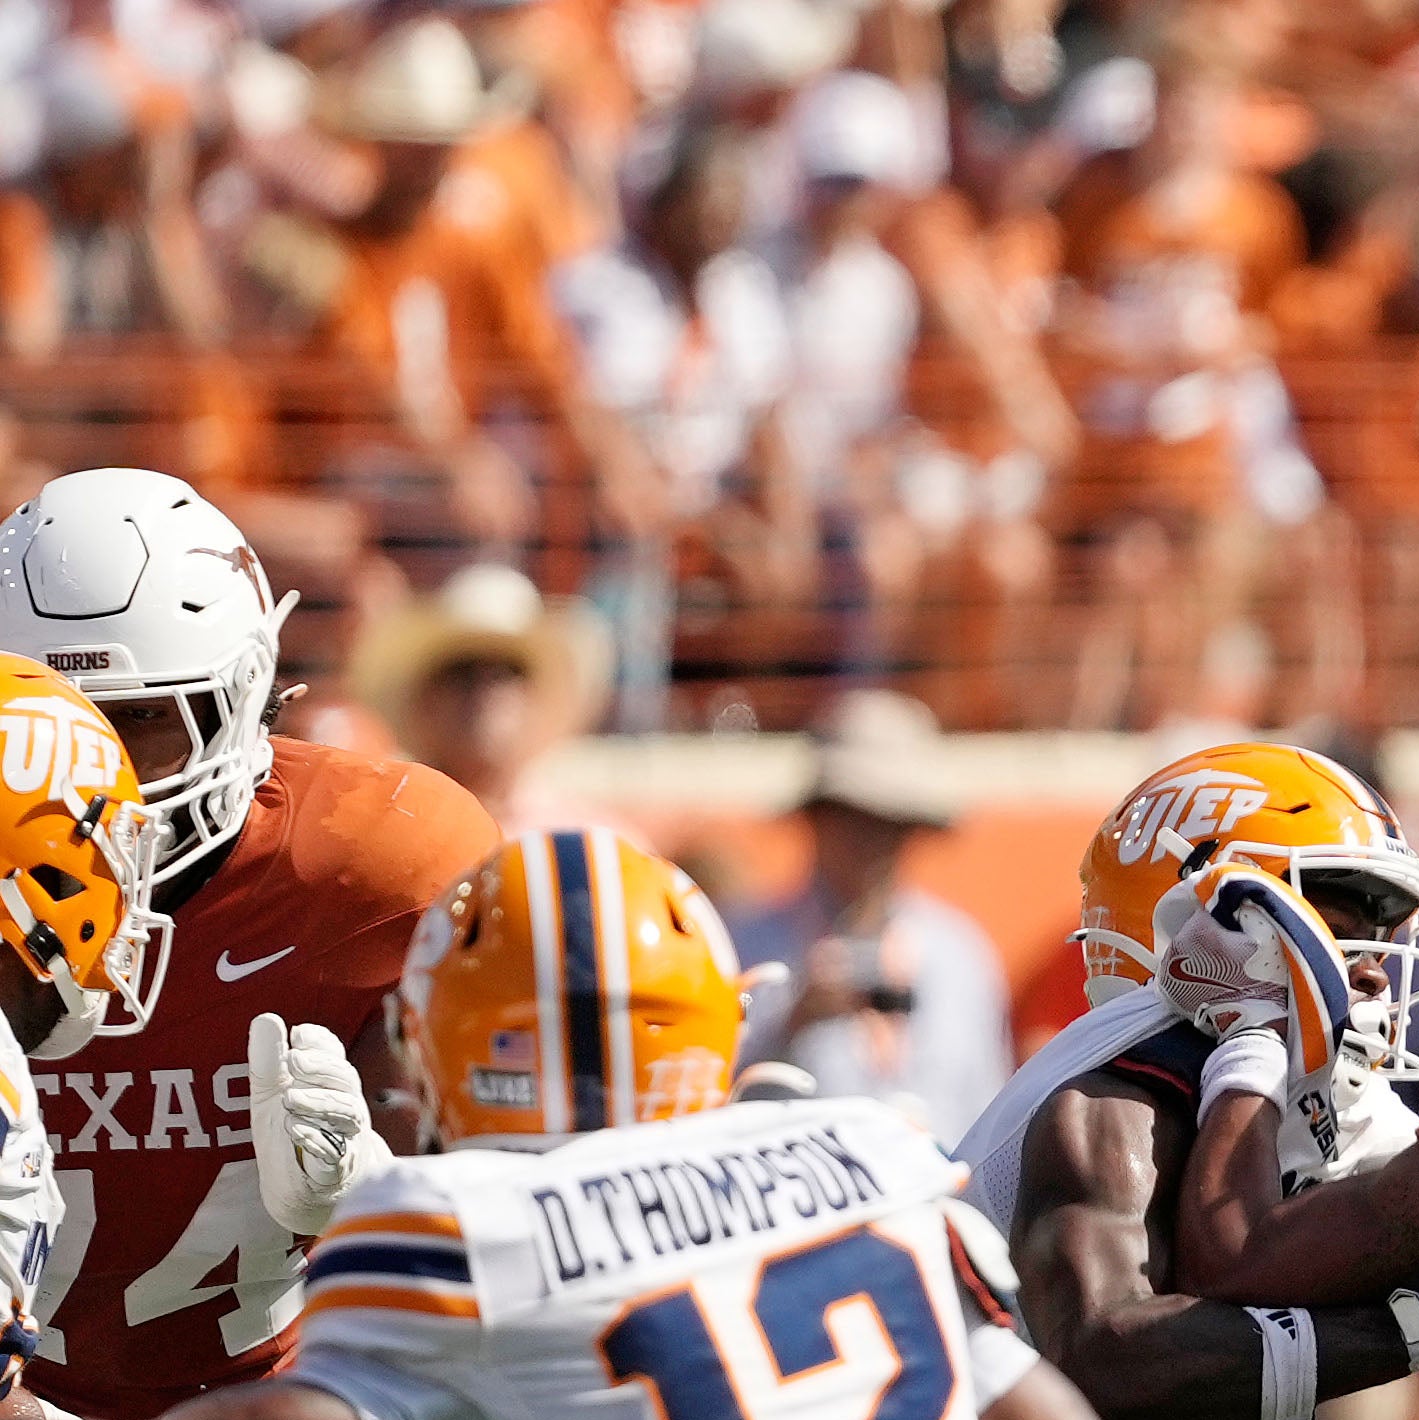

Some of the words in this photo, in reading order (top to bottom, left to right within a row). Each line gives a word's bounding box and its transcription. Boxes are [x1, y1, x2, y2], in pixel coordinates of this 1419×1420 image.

[46, 652, 110, 671] HORNS
[0, 696, 122, 800] UTEP
[1118, 768, 1269, 866] UTEP
[531, 1124, 886, 1280] D.THOMPSON
